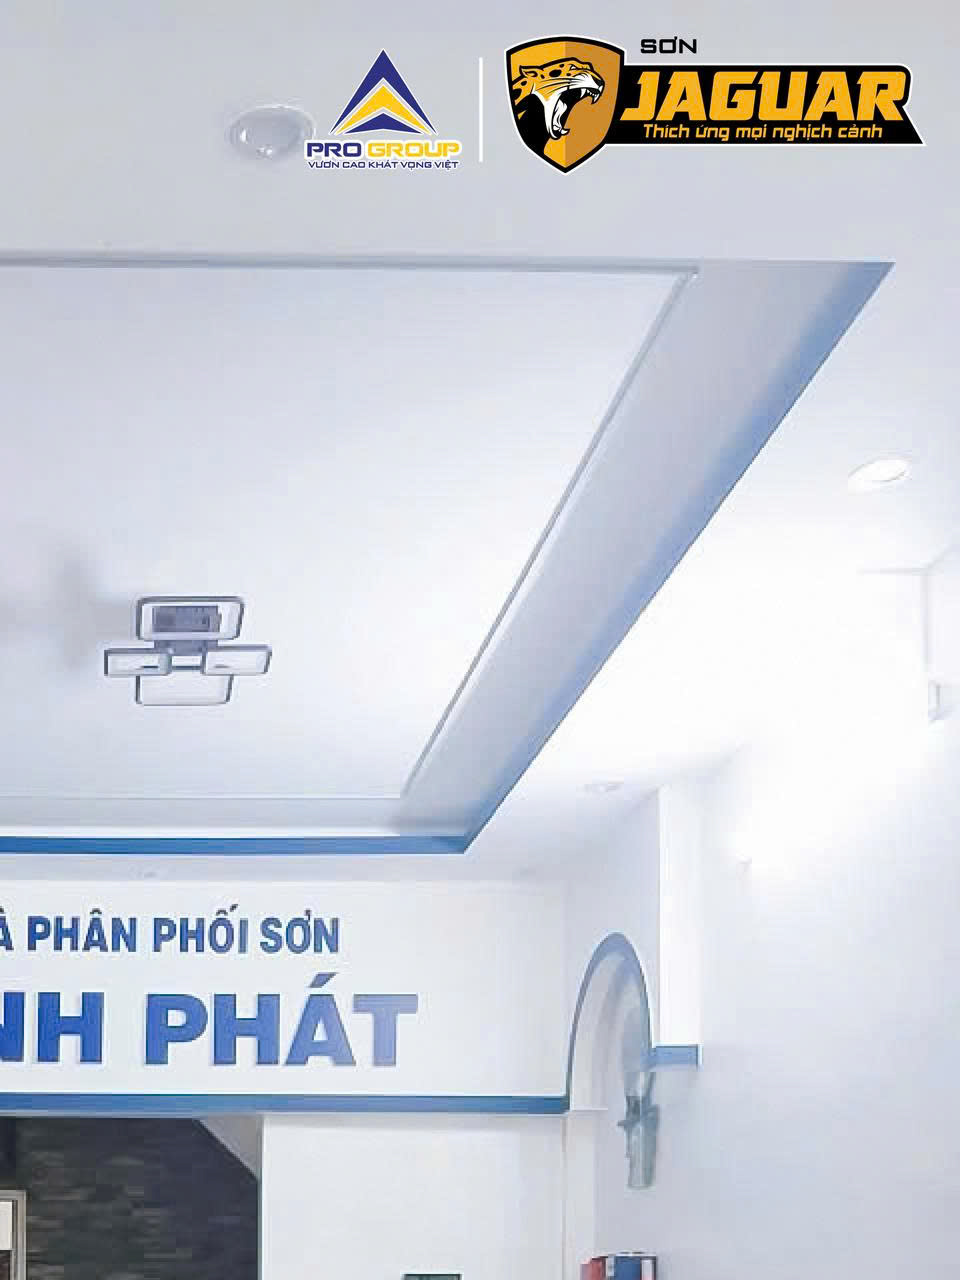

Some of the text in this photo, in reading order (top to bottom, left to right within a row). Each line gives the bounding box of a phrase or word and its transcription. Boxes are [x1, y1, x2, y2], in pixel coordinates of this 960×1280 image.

[27, 906, 137, 953] PHÂN
[152, 904, 248, 953] PHỐI
[260, 914, 340, 954] SƠN
[145, 972, 418, 1068] PHÁT
